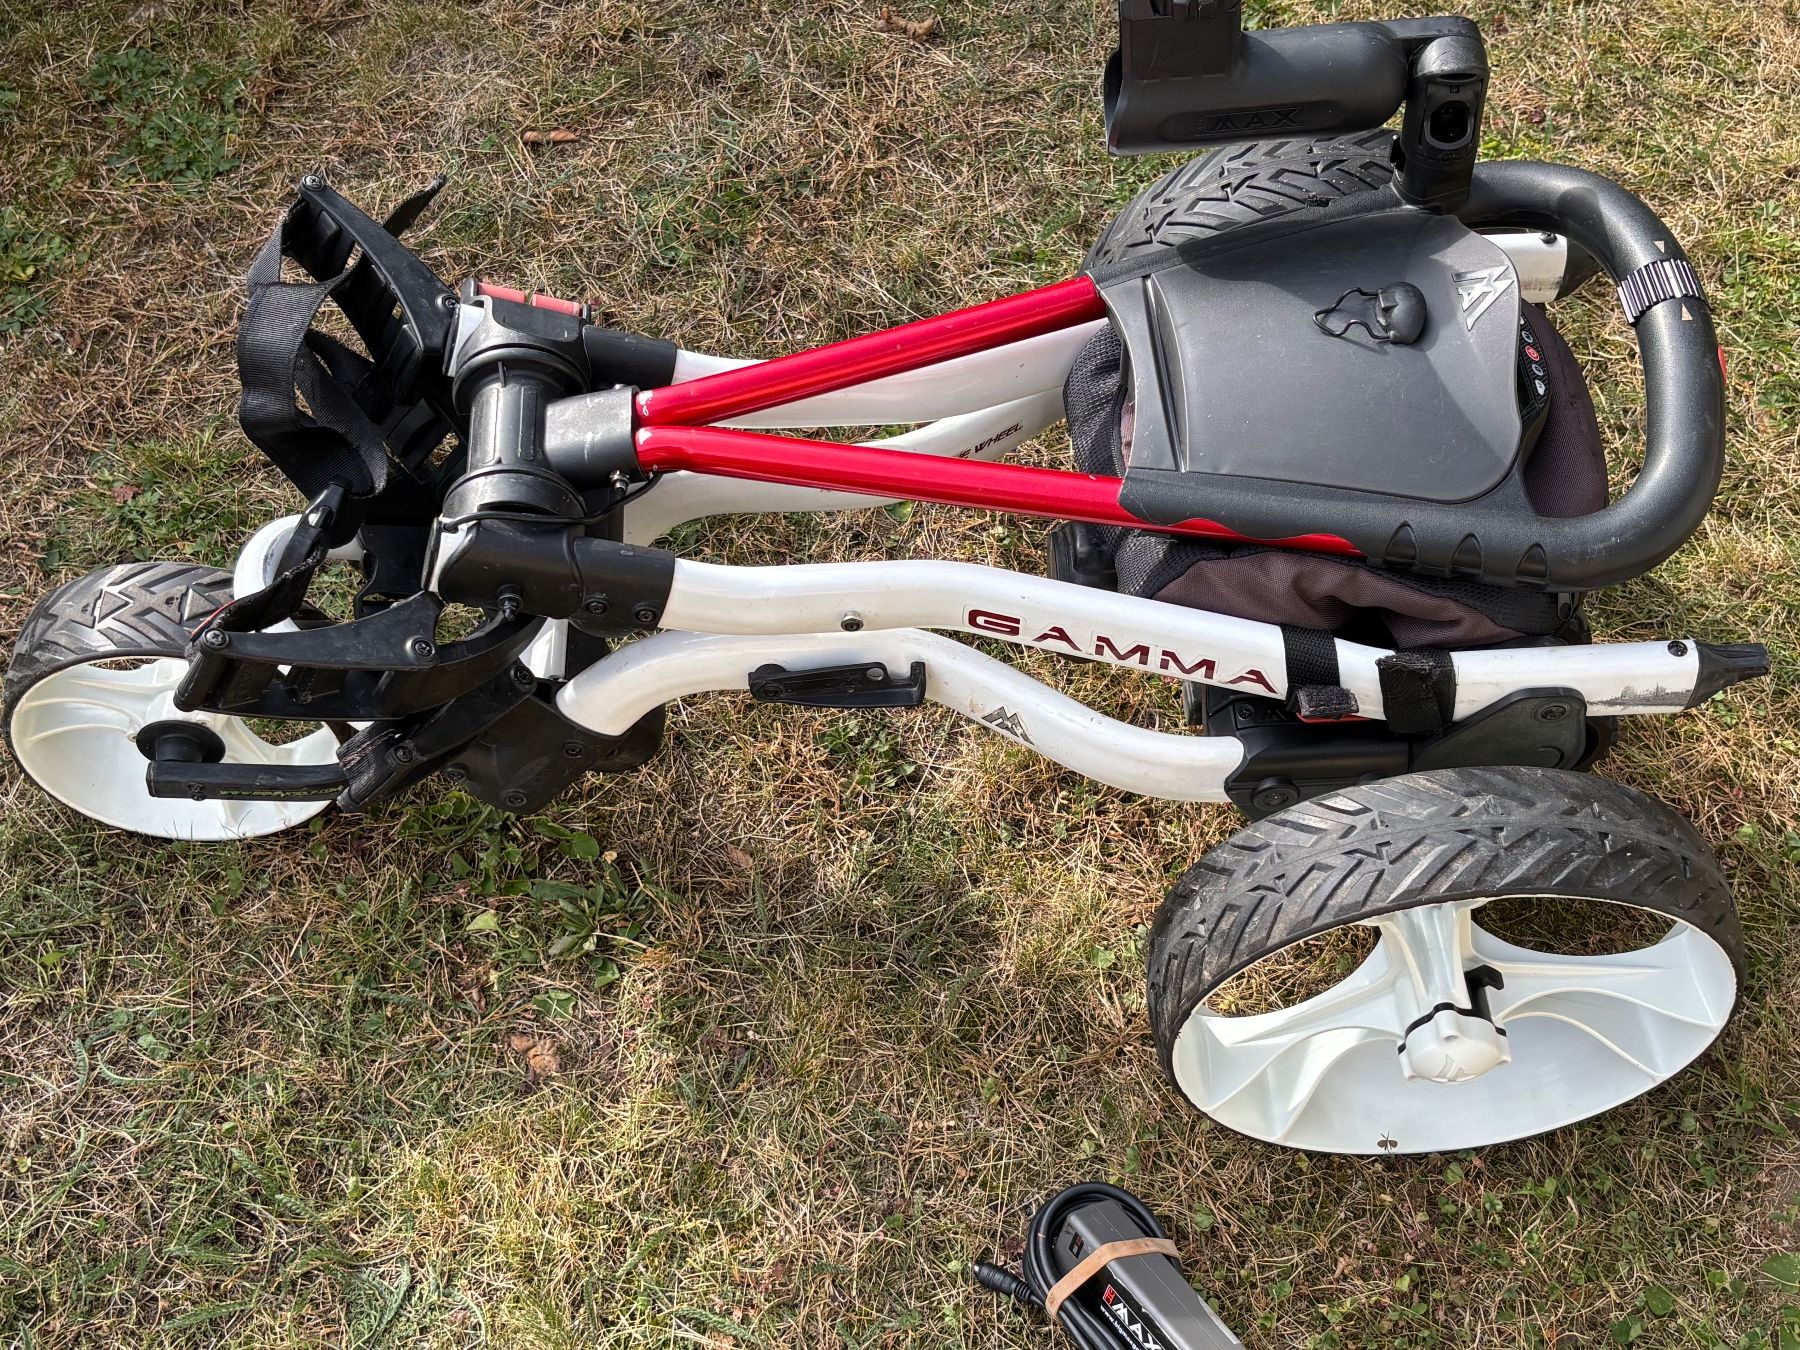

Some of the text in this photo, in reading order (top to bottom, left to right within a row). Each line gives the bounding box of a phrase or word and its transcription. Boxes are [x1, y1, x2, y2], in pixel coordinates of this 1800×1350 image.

[974, 422, 1023, 454] WHEEL
[967, 609, 1278, 694] GAMMA
[1111, 1302, 1163, 1350] MAX
